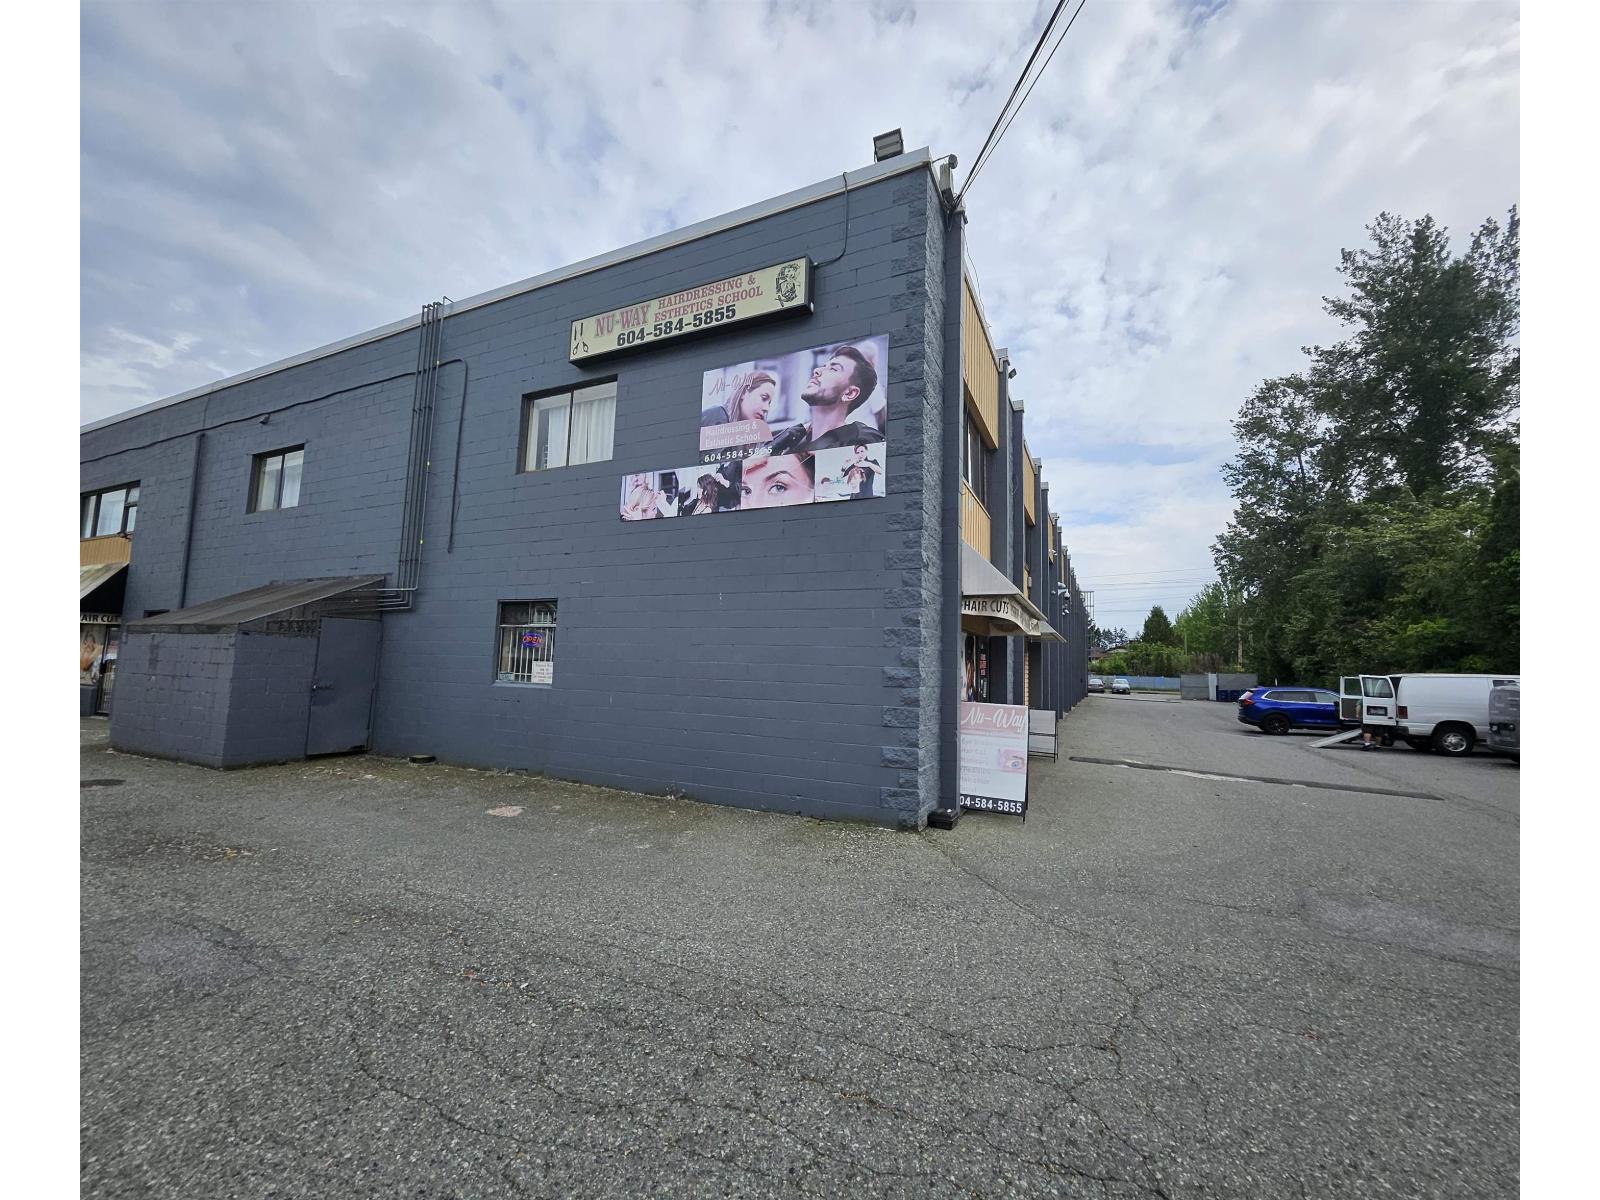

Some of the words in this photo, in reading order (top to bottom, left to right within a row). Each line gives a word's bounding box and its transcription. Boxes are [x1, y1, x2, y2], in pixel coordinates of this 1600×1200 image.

[658, 277, 742, 310] HAIRDRESSING
[747, 274, 756, 286] &
[654, 298, 713, 323] ESTHETICS
[717, 286, 763, 306] SCHOOL
[594, 304, 650, 338] NU-WAY
[617, 304, 736, 347] 604-584-5855
[735, 432, 760, 444] School
[963, 600, 988, 612] HAIR
[990, 600, 1009, 614] CUTS
[80, 614, 98, 622] AIR
[522, 635, 545, 643] OPEN
[960, 707, 1025, 732] Nu-Way
[960, 796, 1022, 813] 04-584-5855
